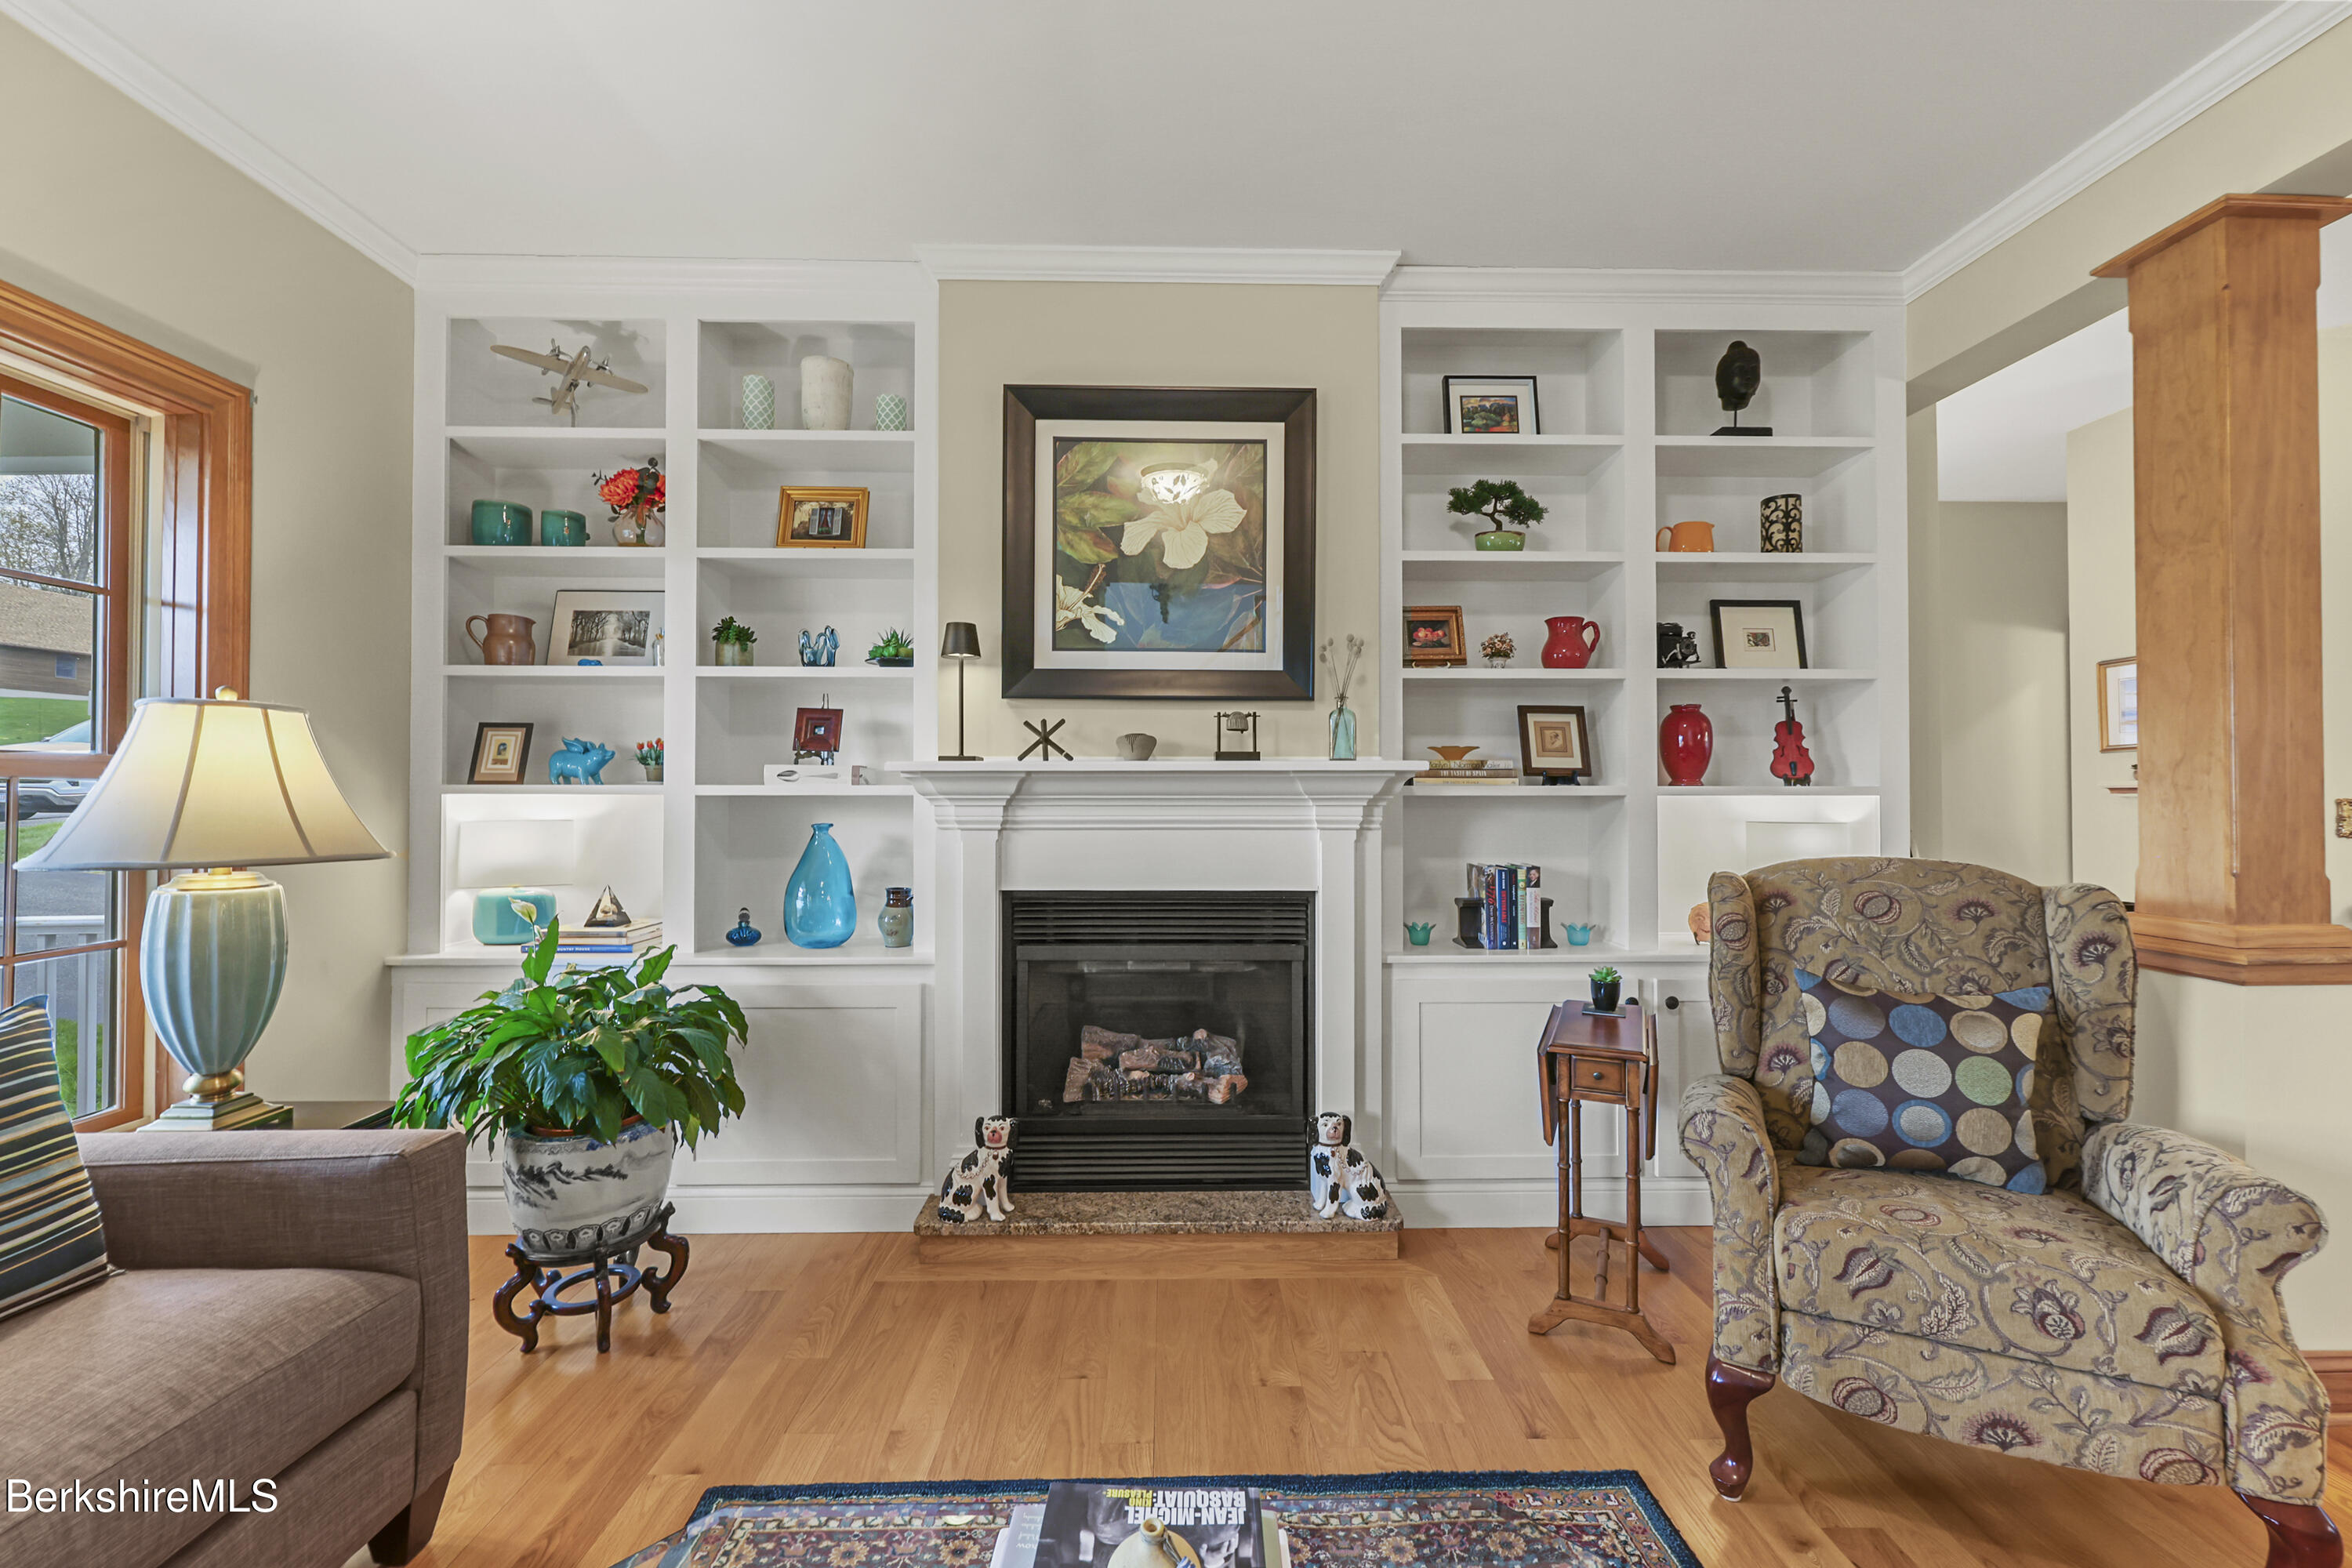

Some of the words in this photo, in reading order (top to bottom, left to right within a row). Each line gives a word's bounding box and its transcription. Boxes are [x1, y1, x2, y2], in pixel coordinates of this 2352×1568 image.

[1430, 760, 1450, 769] arilyn
[1486, 886, 1496, 906] 1776
[1152, 1489, 1247, 1508] BASQUIAT:
[1124, 1506, 1247, 1526] JEAN-MICHEL
